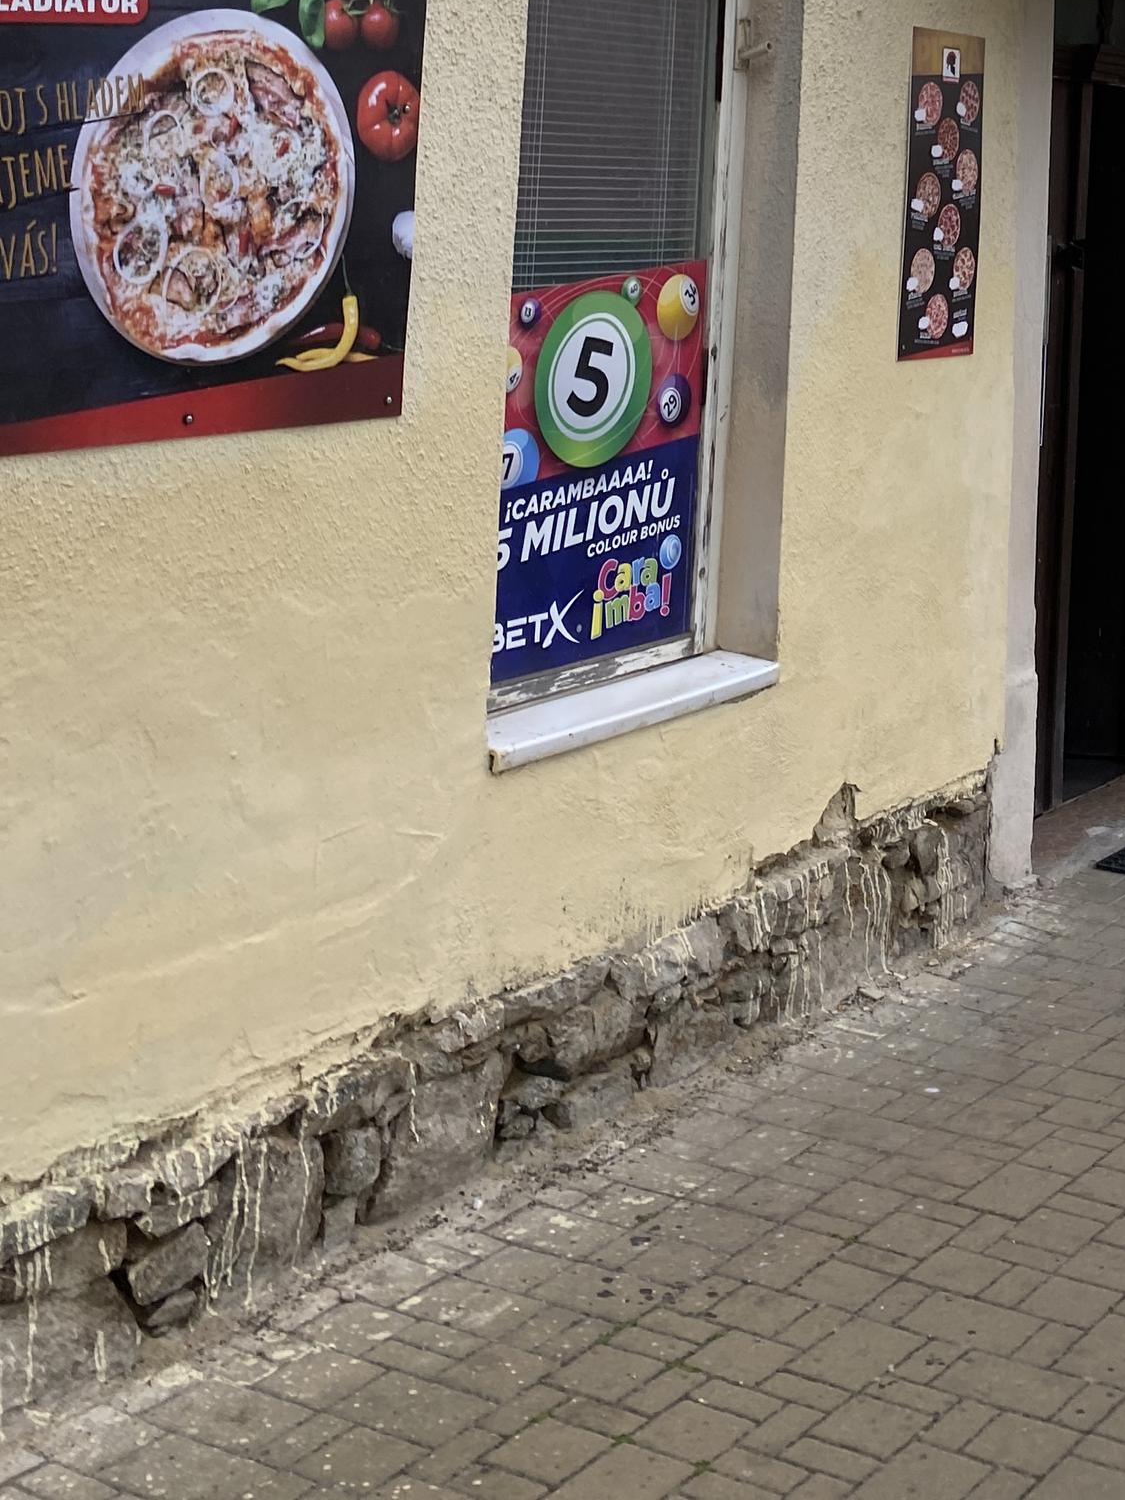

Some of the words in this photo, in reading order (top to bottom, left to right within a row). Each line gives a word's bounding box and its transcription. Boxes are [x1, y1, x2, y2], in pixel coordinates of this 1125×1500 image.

[35, 84, 49, 126] S
[56, 73, 146, 122] HLADEM
[0, 219, 58, 281] VÁS!
[566, 336, 614, 417] 5
[663, 394, 679, 418] 29
[520, 468, 676, 563] MILIONŮ
[586, 529, 638, 558] COLOUR
[639, 515, 681, 540] BONUS
